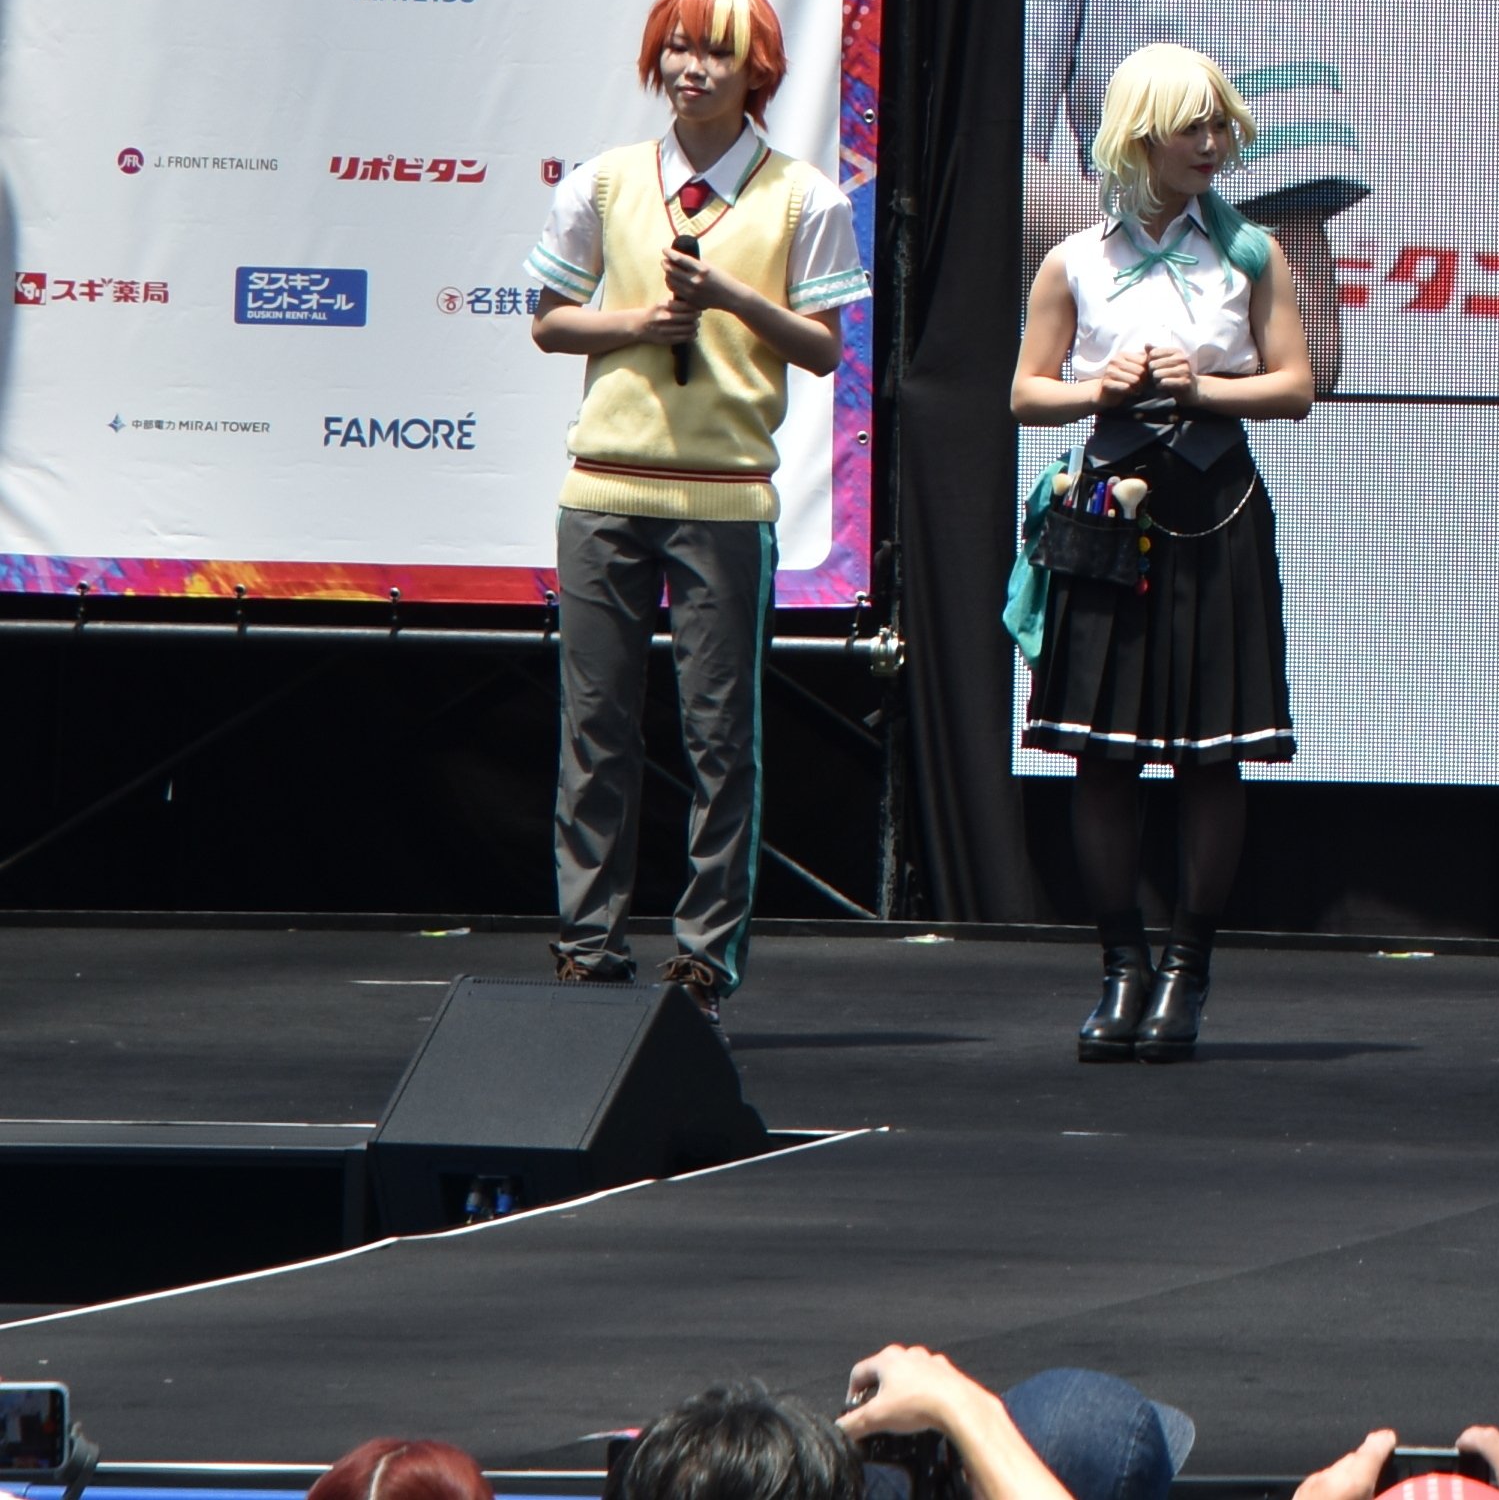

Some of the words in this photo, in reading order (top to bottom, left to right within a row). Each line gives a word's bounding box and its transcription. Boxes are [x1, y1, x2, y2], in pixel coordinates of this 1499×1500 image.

[154, 157, 164, 168] J.
[168, 157, 209, 169] FRONT
[212, 157, 278, 171] RETAILING
[329, 154, 488, 183] リポビタン
[51, 278, 169, 304] スギ薬局
[247, 311, 283, 319] DUSKIN
[132, 419, 176, 431] 中部電力
[178, 420, 218, 432] MIRAI
[221, 421, 271, 433] TOWER
[323, 411, 476, 450] FAMORÉ
